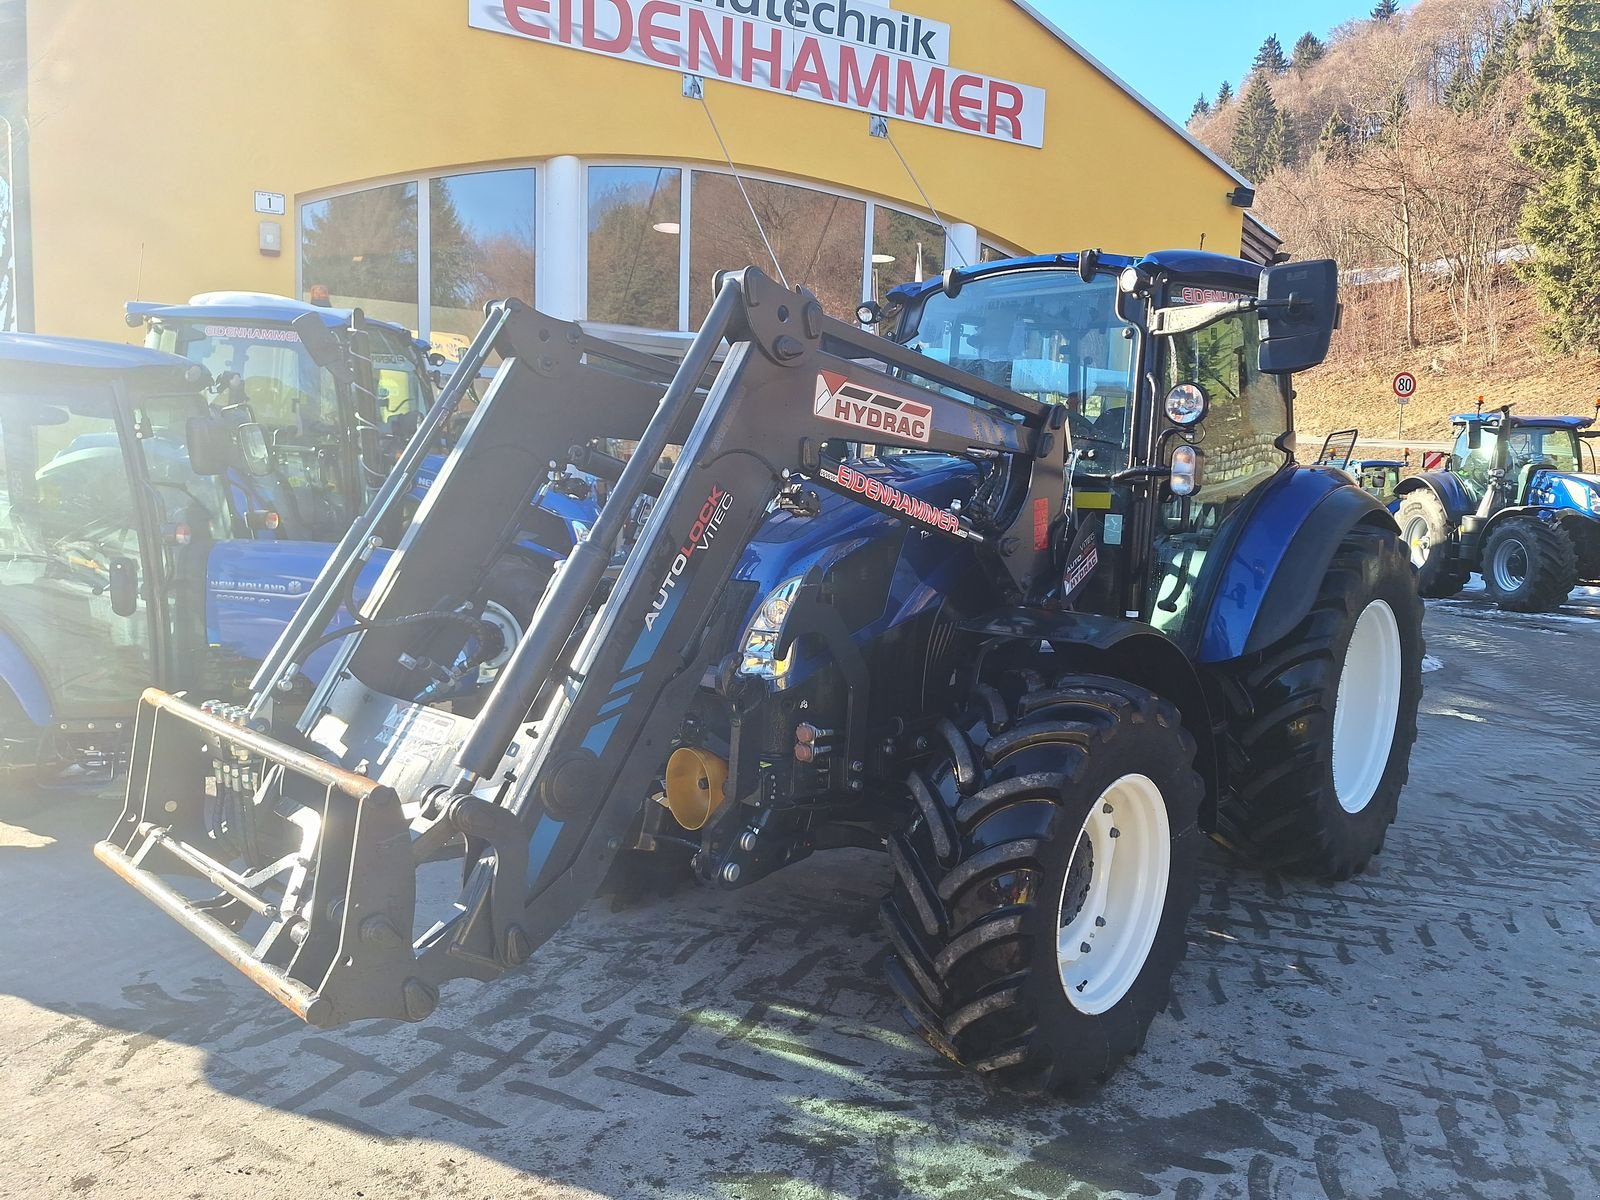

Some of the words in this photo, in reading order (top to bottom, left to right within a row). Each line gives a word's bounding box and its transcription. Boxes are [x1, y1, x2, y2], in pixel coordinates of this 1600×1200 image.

[697, 0, 937, 60] technik
[502, 0, 1024, 140] EIDENHAMMER
[267, 197, 272, 209] 1
[1398, 377, 1412, 392] 80
[834, 398, 925, 439] HYDRAC
[696, 491, 734, 550] VITEC
[644, 484, 724, 632] AUTOLOCK
[210, 580, 235, 588] NEW
[238, 582, 286, 592] HOLLAND
